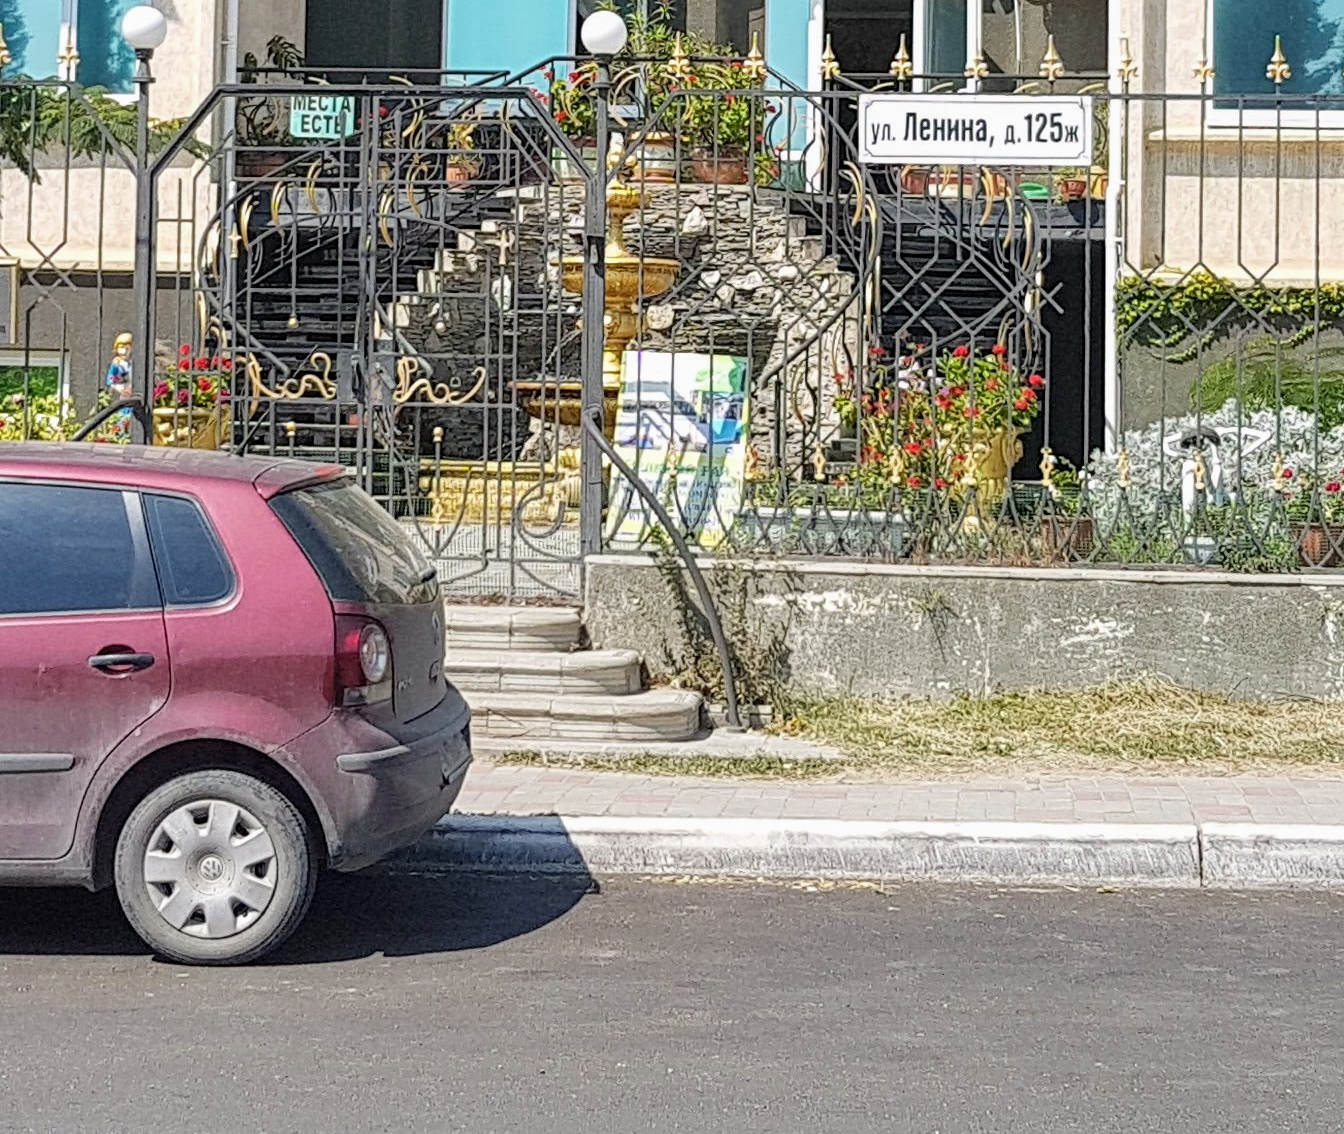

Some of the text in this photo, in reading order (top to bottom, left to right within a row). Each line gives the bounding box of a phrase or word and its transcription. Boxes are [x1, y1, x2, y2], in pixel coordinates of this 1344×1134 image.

[293, 95, 351, 113] МЕСТА
[871, 122, 896, 145] ул.
[903, 112, 995, 148] Ленина,
